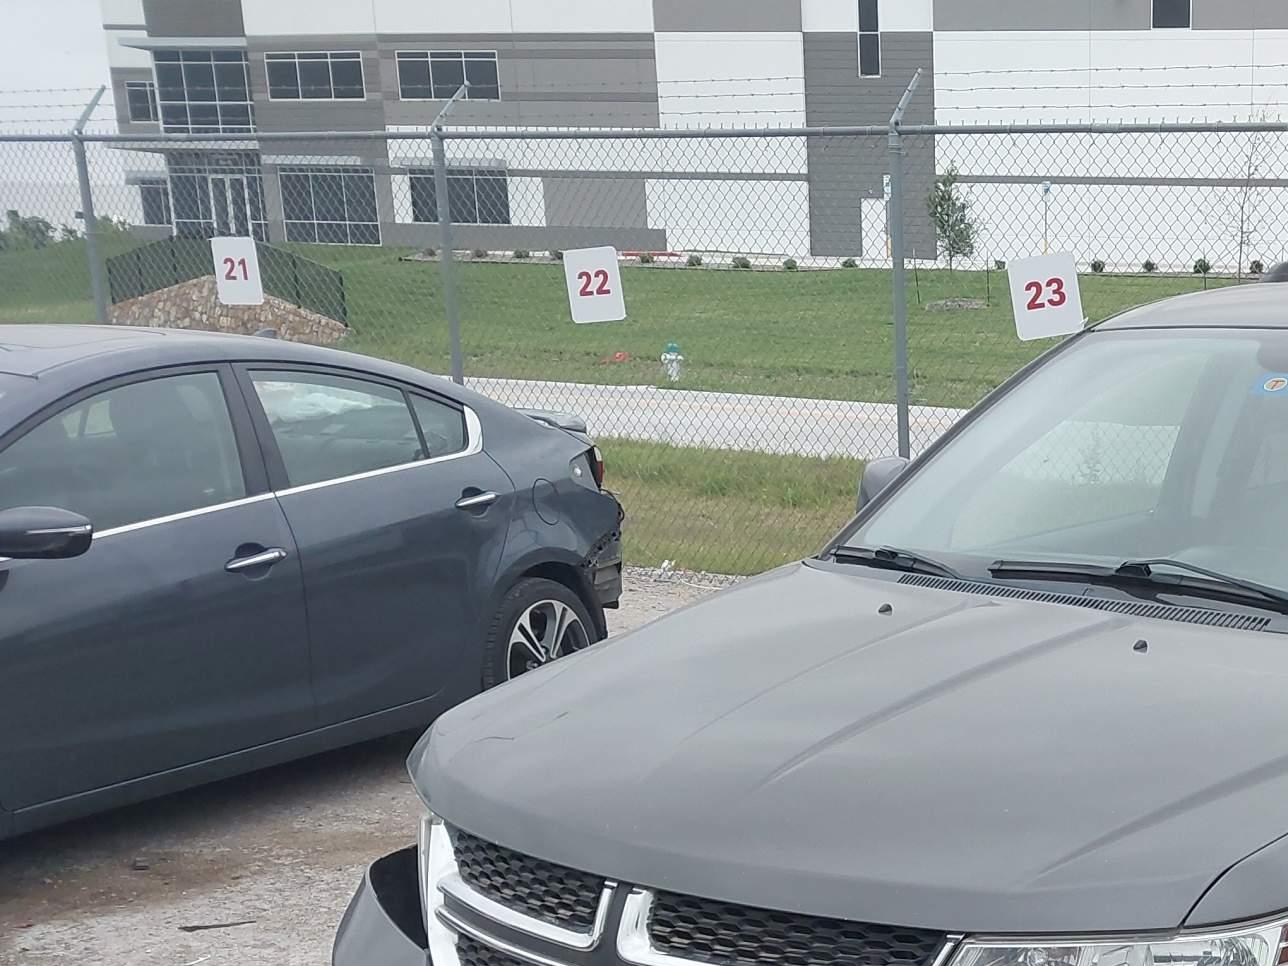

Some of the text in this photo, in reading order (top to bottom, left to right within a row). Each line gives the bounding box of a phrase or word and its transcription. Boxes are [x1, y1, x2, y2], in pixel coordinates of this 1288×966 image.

[223, 257, 248, 281] 21
[577, 269, 611, 297] 22
[1024, 277, 1067, 311] 23
